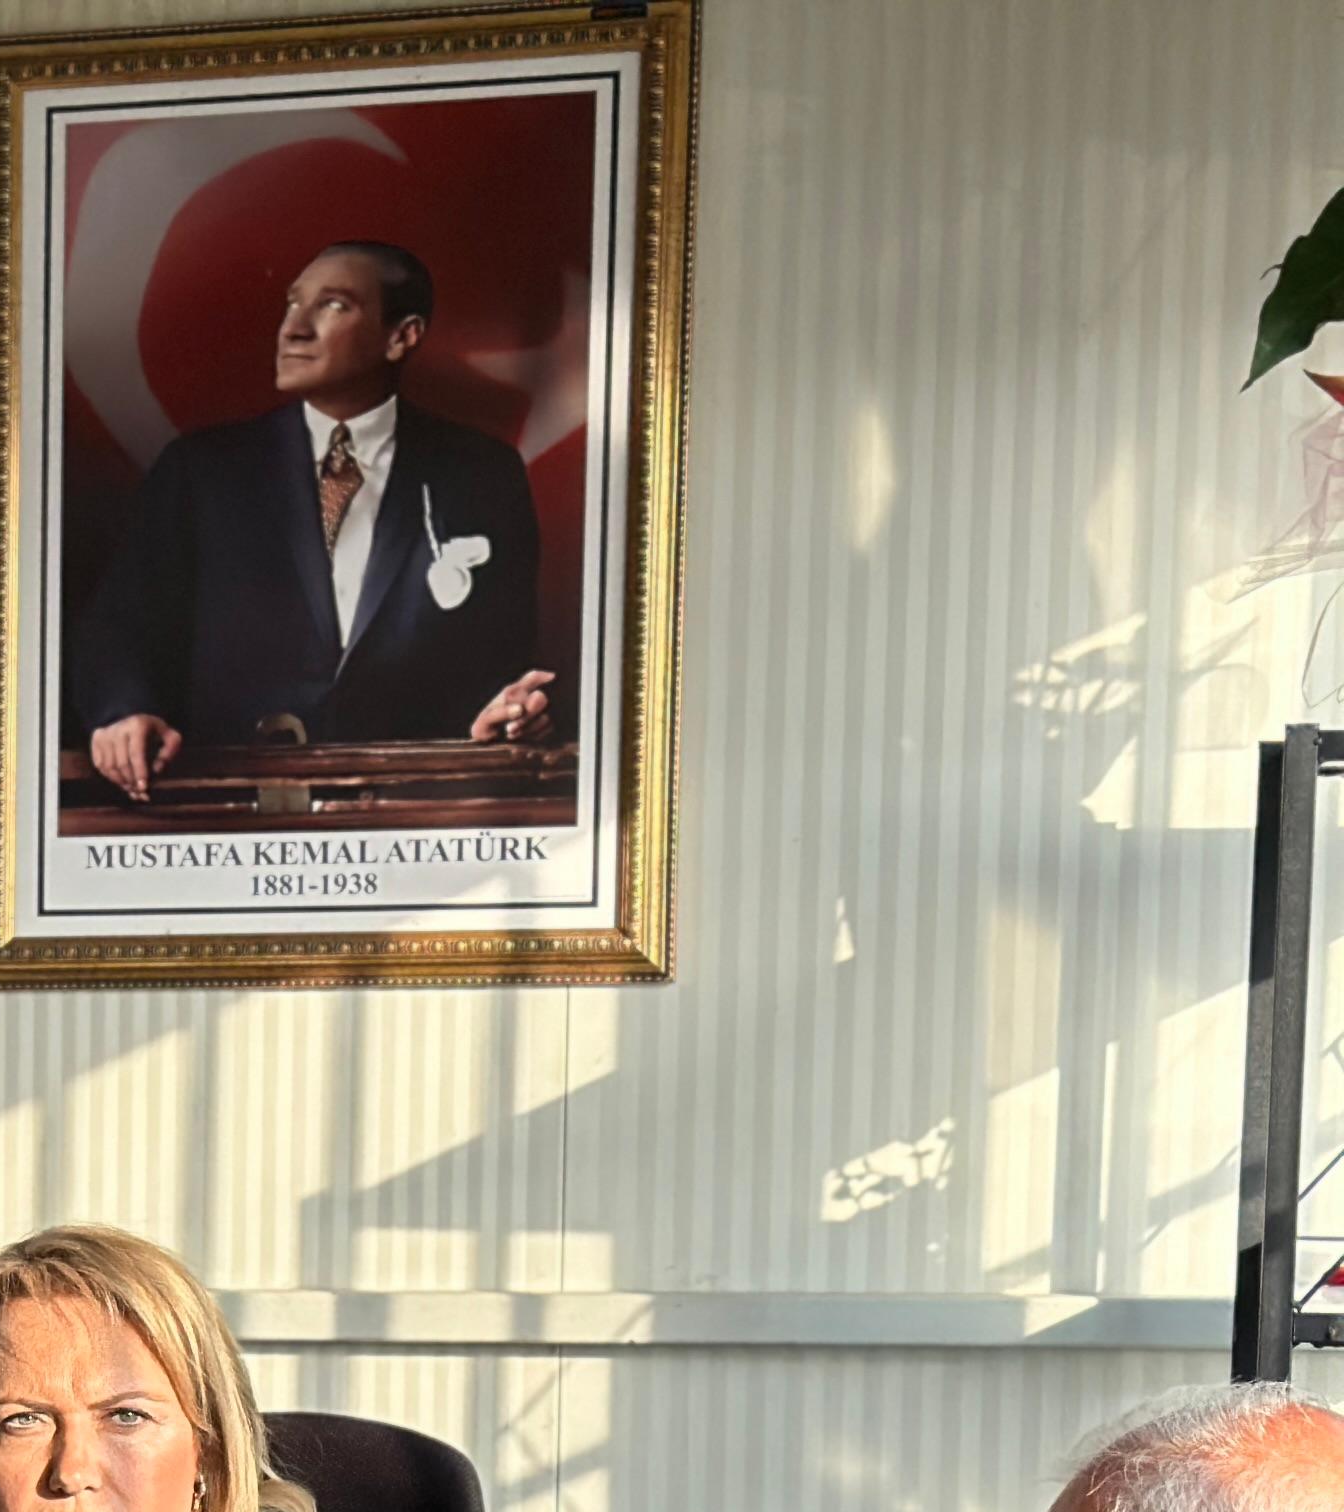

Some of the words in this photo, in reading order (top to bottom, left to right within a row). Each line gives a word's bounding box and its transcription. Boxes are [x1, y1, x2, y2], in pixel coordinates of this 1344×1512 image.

[86, 842, 243, 869] MUSTAFA
[252, 839, 378, 867] KEMAL
[385, 831, 548, 863] ATATÜRK
[250, 872, 378, 897] 1881-1938
